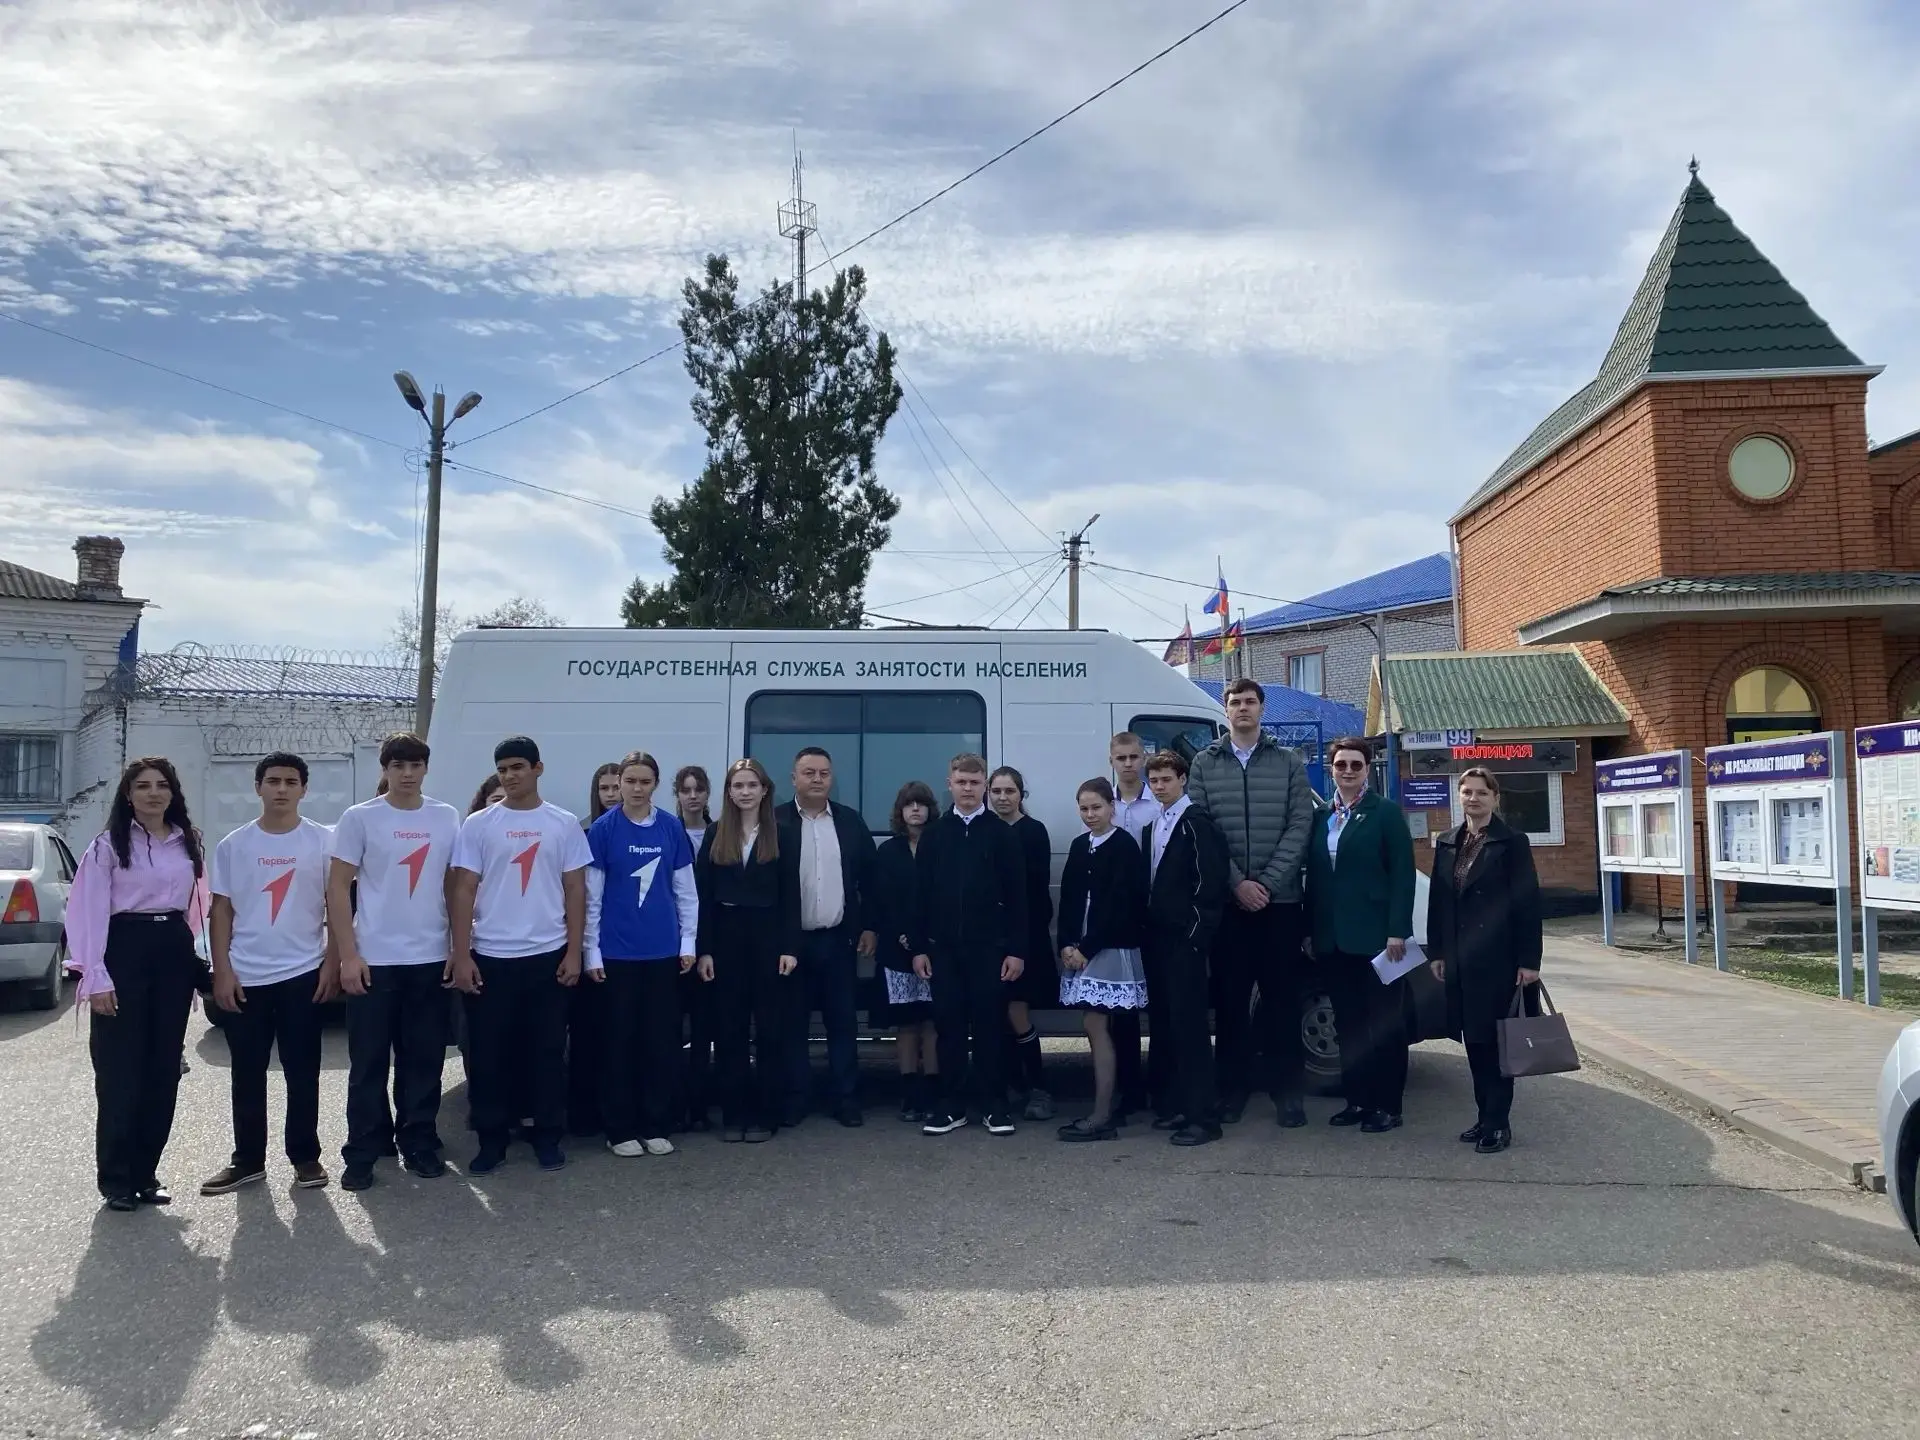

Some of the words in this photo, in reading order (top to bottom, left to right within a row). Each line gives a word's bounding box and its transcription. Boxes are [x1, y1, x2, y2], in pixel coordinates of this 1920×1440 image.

[567, 660, 757, 678] ГОСУДАРСТВЕННАЯ
[767, 660, 845, 677] СЛУЖБА
[855, 661, 966, 678] ЗАНЯТОСТИ
[976, 662, 1088, 678] НАСЕЛЕНИЯ
[1448, 729, 1471, 745] 99
[1453, 744, 1533, 760] ПОЛИЦИЯ
[1775, 753, 1805, 771] ПОЛИЦИЯ
[393, 830, 431, 840] Первые
[505, 830, 542, 840] Первые
[628, 844, 662, 855] Первые
[257, 856, 297, 868] Первые
